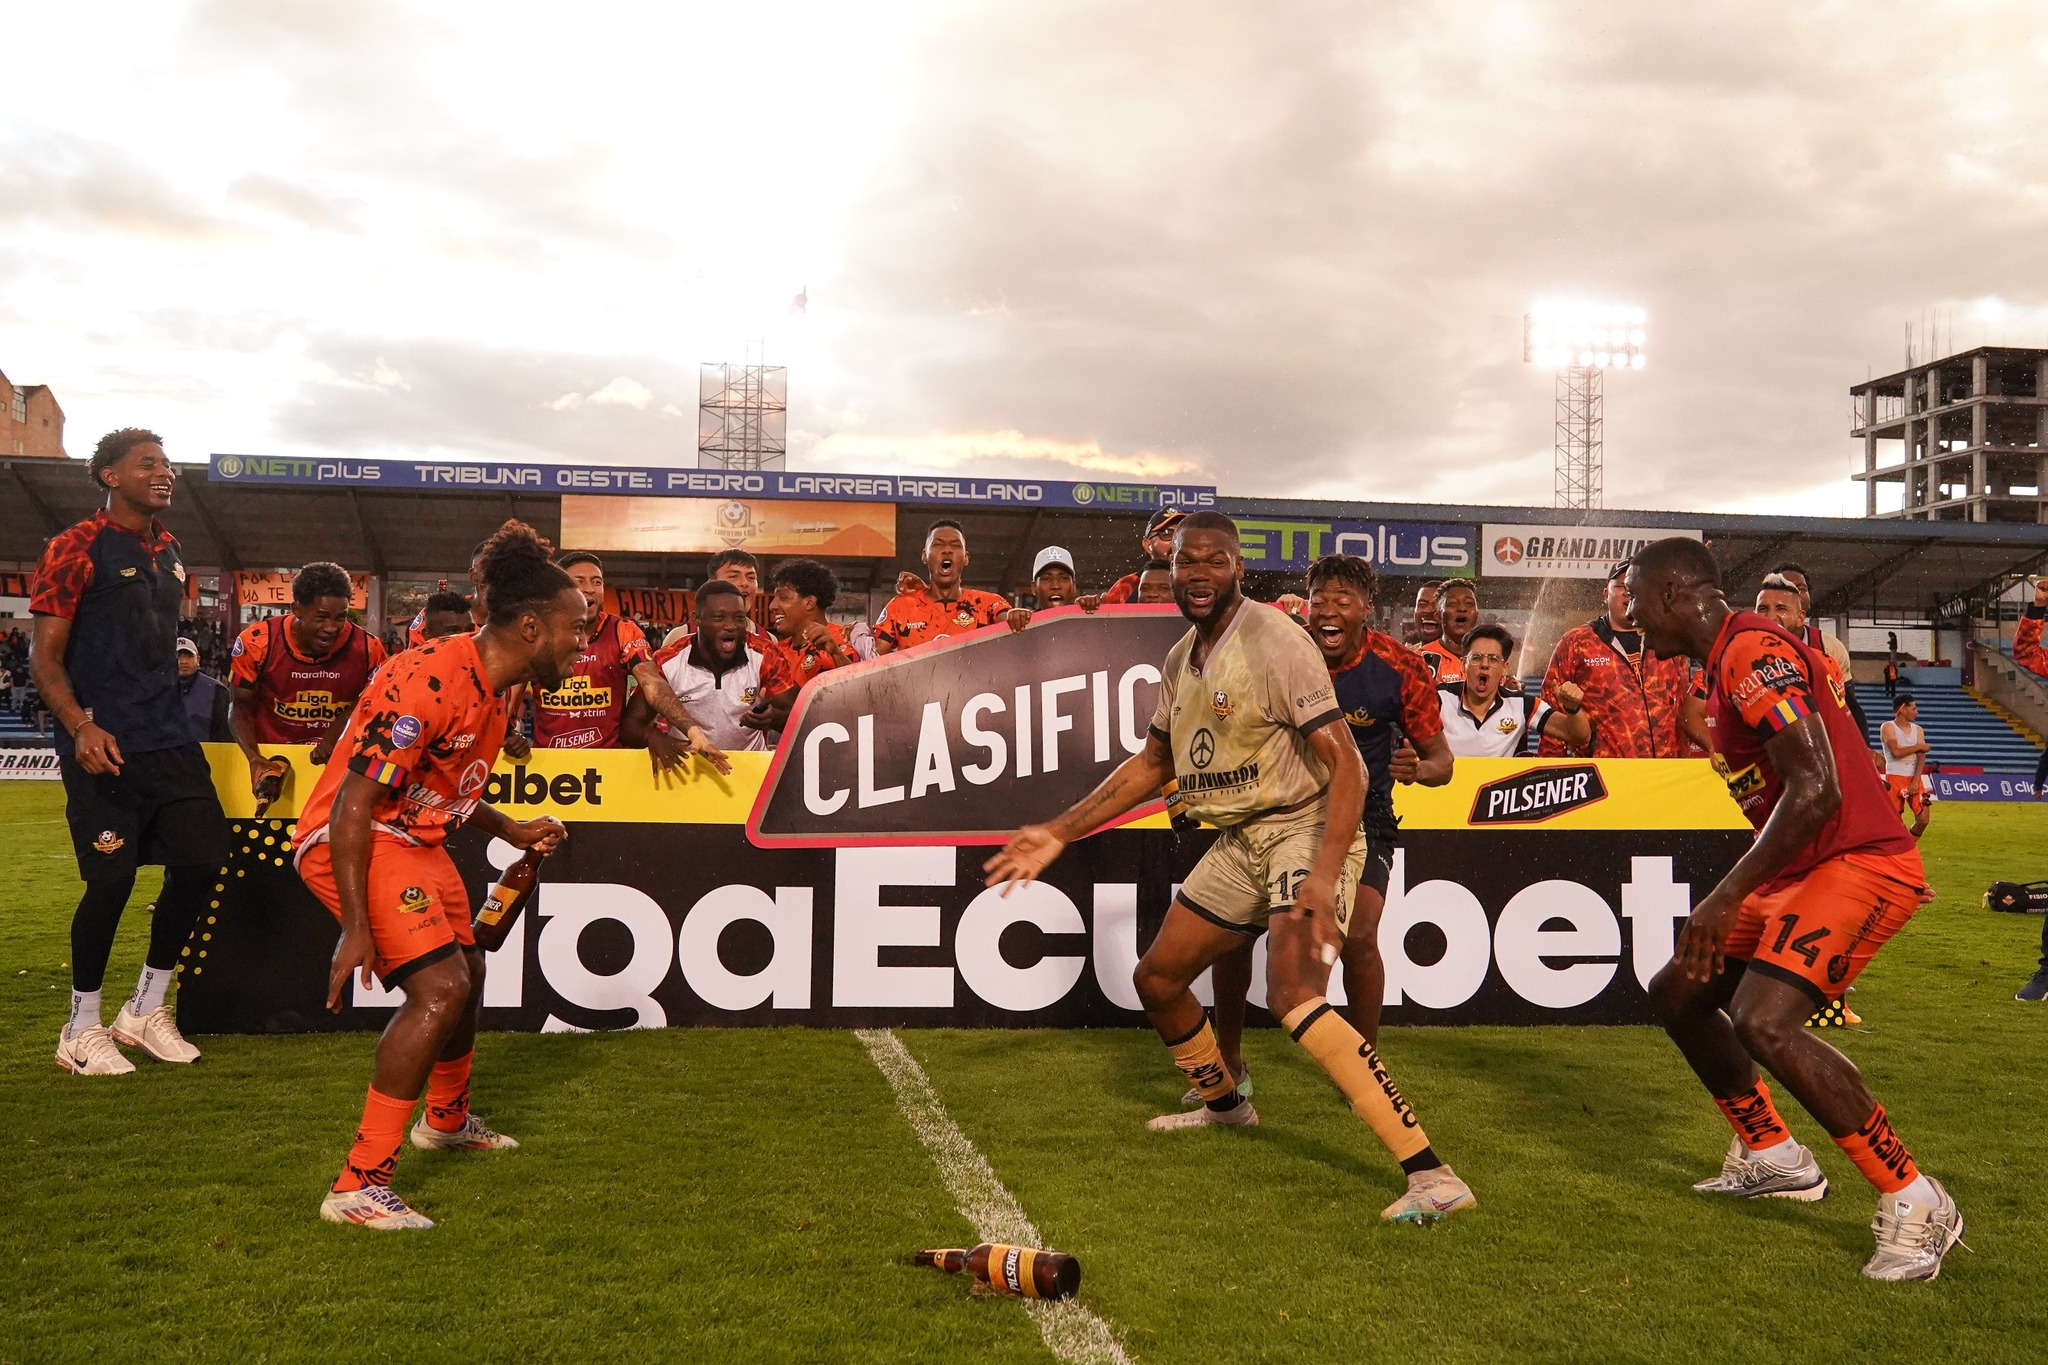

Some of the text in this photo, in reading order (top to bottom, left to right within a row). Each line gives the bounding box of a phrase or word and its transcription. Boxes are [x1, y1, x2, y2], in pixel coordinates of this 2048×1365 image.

[414, 465, 1043, 501] TRIBUNA OESTE: PEDRO LARREA ARELLANO
[616, 589, 691, 623] GLORIA
[291, 671, 341, 680] marathon
[563, 679, 588, 692] Liga
[299, 691, 329, 707] Liga
[541, 691, 610, 707] Ecuabet
[554, 730, 596, 748] PILSENER
[803, 663, 1162, 817] CLASIFIC
[1487, 772, 1589, 818] PILSENER
[1953, 779, 1990, 795] clipp
[1771, 913, 1832, 969] 14
[1004, 1248, 1021, 1293] PILSENER
